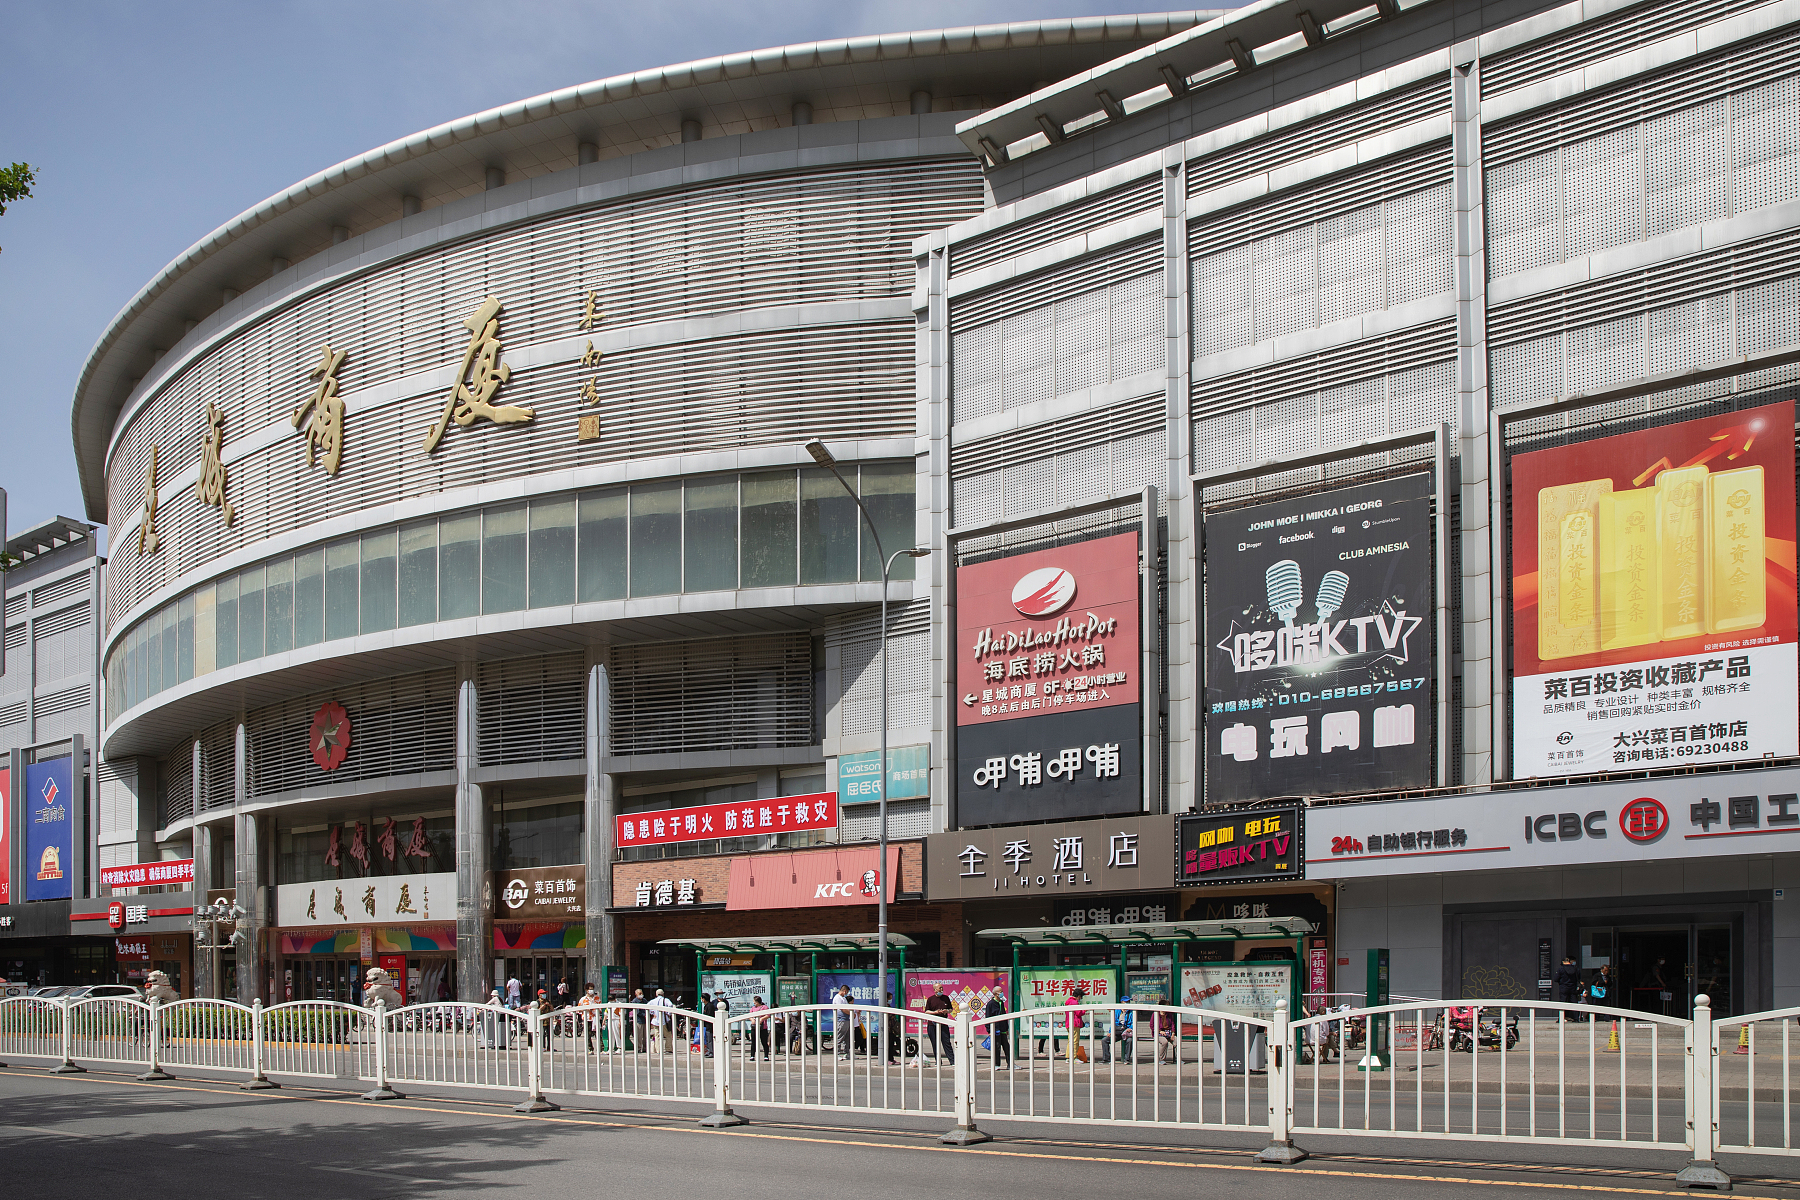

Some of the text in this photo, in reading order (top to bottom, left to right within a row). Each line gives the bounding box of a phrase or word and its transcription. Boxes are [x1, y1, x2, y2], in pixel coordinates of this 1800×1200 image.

[1248, 519, 1275, 532] JOHN
[1277, 514, 1299, 527] MOE
[1306, 507, 1339, 521] MIKKA
[1346, 499, 1383, 514] GEORG
[1331, 525, 1346, 534] digg
[1338, 541, 1410, 561] CLUB AMNESIA
[1675, 534, 1698, 624] 投资金条
[1727, 522, 1750, 611] 投资金条
[1567, 543, 1588, 622] 投资金条
[1626, 544, 1647, 623] 投资金条
[1704, 635, 1780, 651] 投资有风险 选择需谨慎
[983, 643, 1106, 682] 海底捞火锅
[981, 671, 1127, 705] 星城商厦 6F 24小时营业
[1544, 655, 1751, 701] 菜百投资收藏产品
[981, 689, 1110, 717] 晚8点后由后门停车场进入
[1543, 681, 1751, 715] 品质精良 专业设计 种类丰富 规格齐全
[1586, 699, 1702, 721] 销售回购紧贴实时金价
[1220, 703, 1415, 762] 电玩网咖
[1613, 719, 1749, 749] 大兴菜百首饰店
[846, 762, 887, 774] watson
[973, 742, 1120, 789] 呷哺呷哺
[1547, 749, 1585, 761] 菜百首饰
[892, 768, 927, 782] 商场首层
[35, 804, 66, 824] 二商肉食
[623, 799, 829, 842] 隐患险于明火 防范胜于救灾
[1525, 809, 1608, 844] ICBC
[1199, 815, 1281, 849] 网咖 电玩
[1331, 828, 1469, 854] 24h 自助银行服务
[957, 831, 1140, 878] 全季酒店
[534, 878, 577, 895] 菜百首饰
[634, 878, 697, 907] 肯德基
[813, 881, 854, 899] KFC
[993, 873, 1092, 890] JI HOTEL
[126, 905, 148, 922] 国美
[534, 896, 577, 905] CAIBAI JEWELRY
[1234, 902, 1270, 919] 哆咪
[1312, 950, 1325, 985] 手机专卖
[1030, 978, 1108, 997] 卫华养老院
